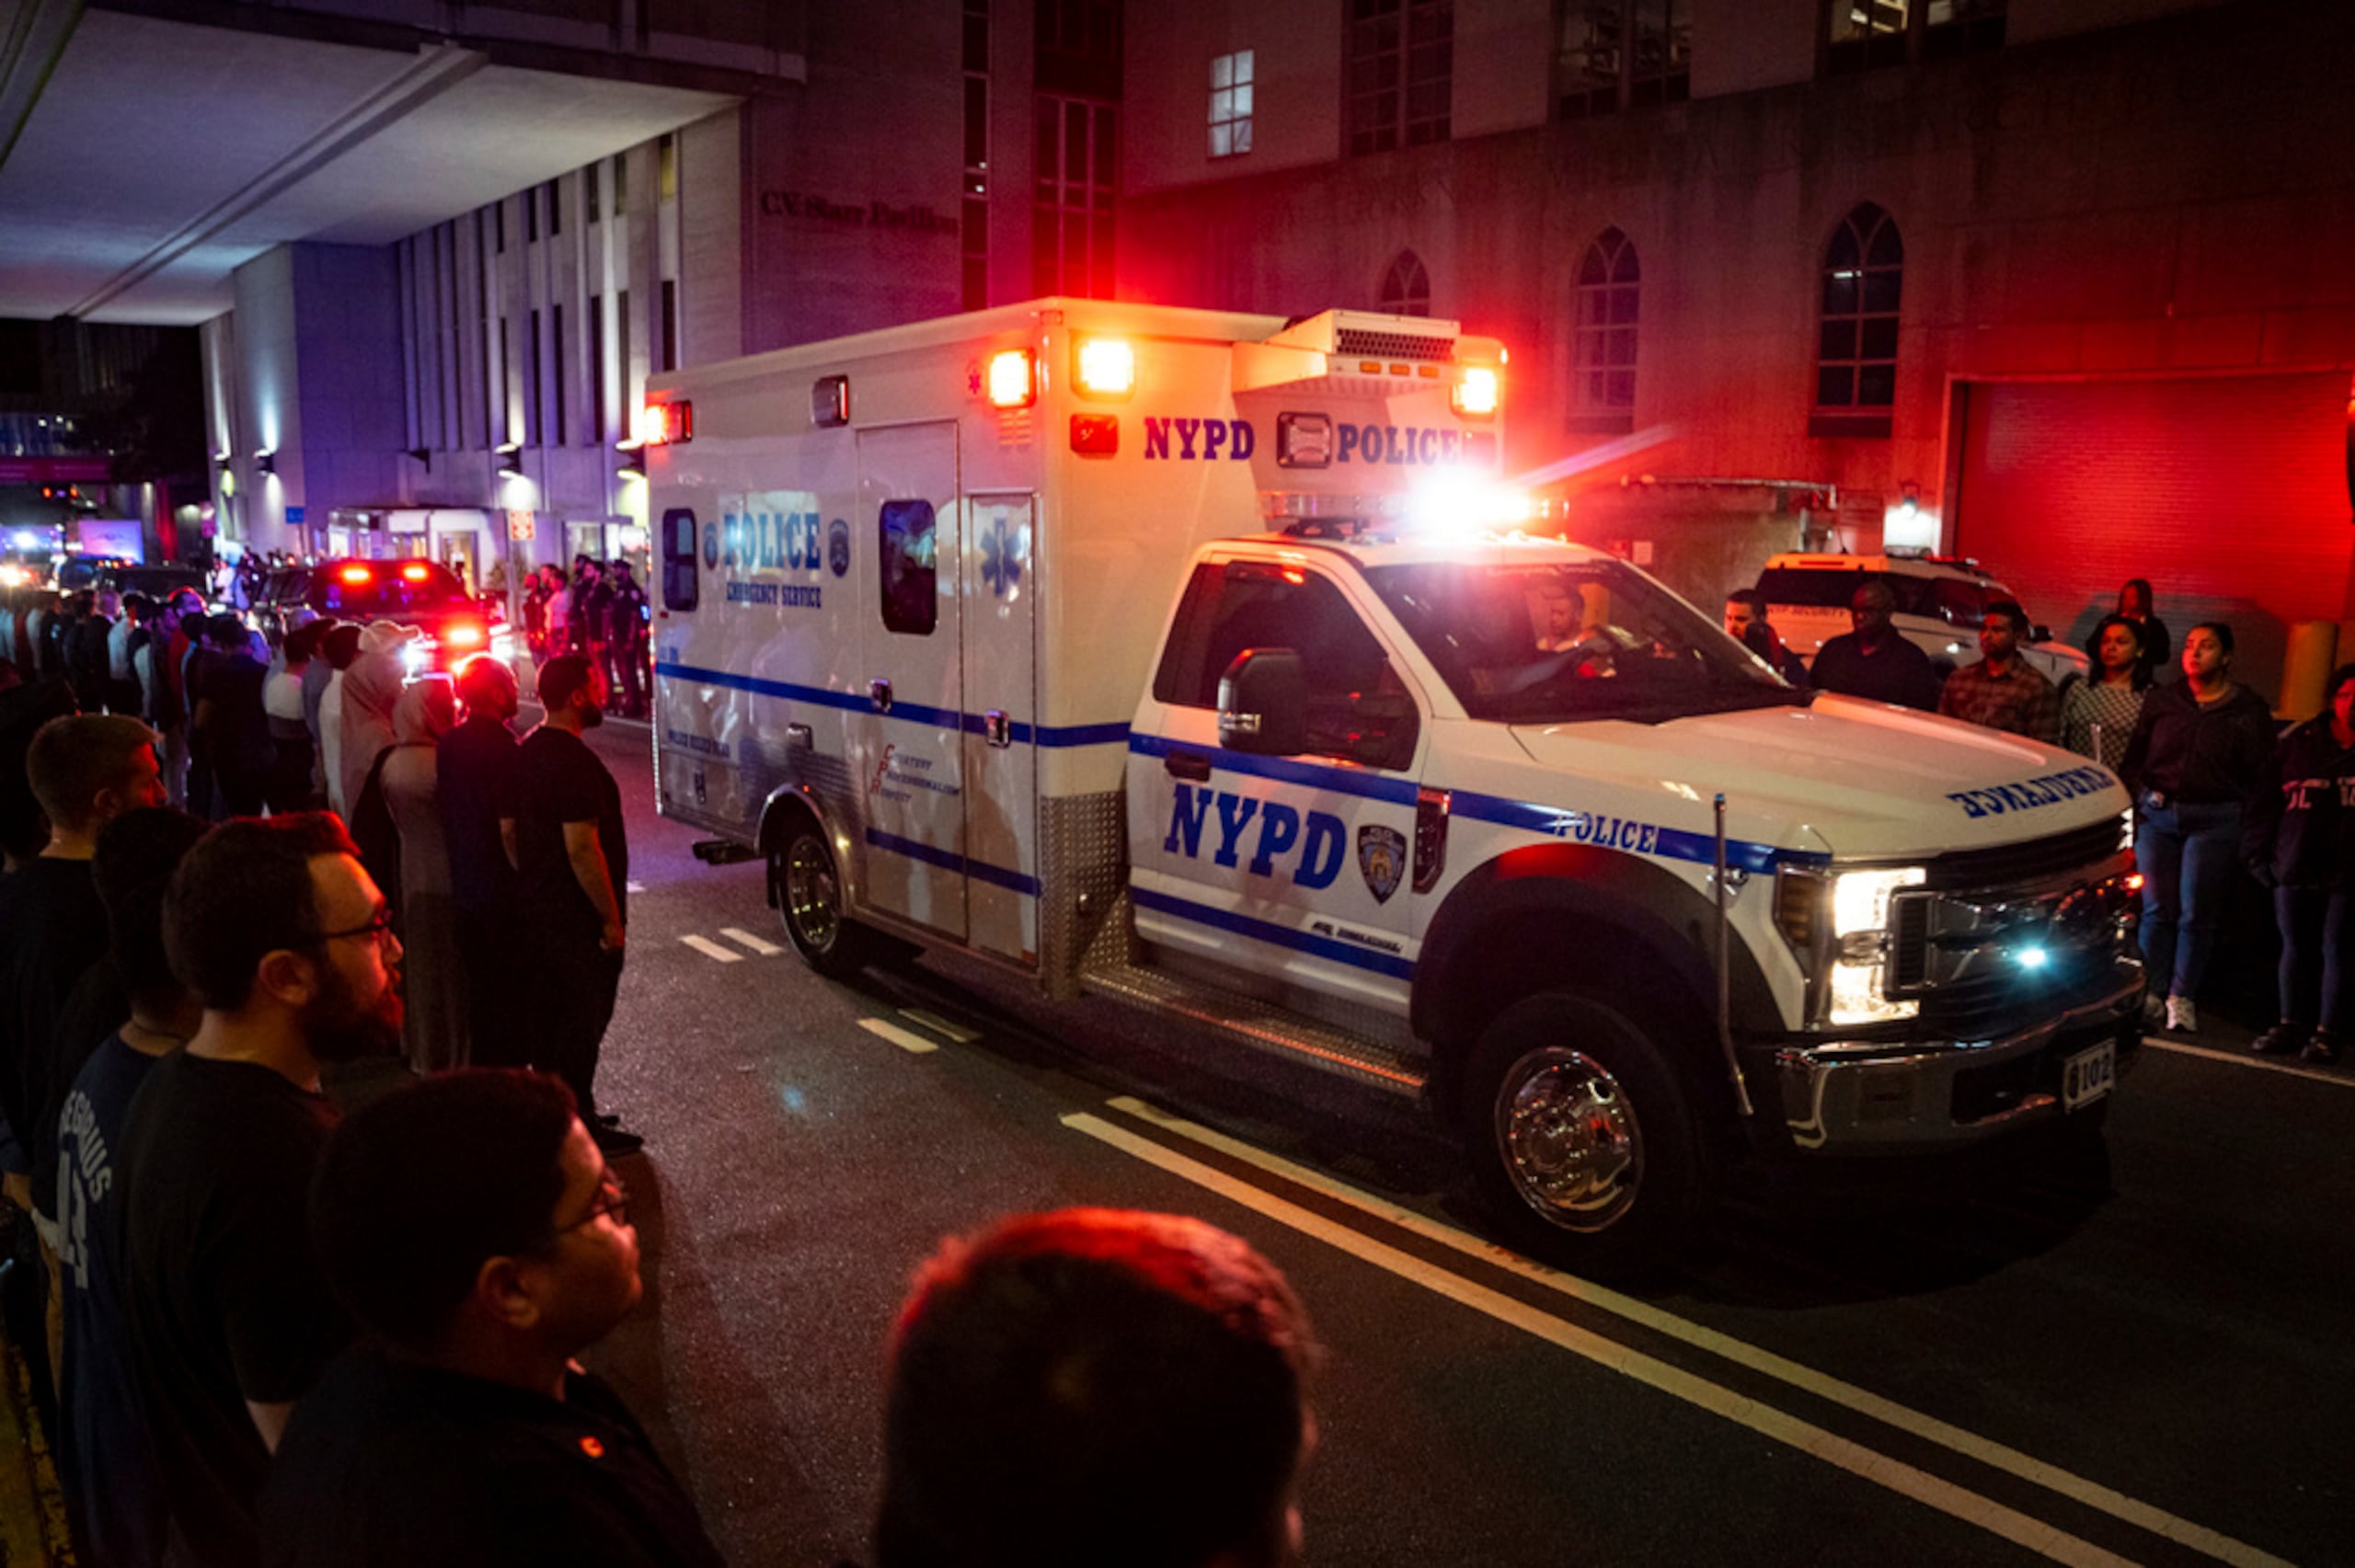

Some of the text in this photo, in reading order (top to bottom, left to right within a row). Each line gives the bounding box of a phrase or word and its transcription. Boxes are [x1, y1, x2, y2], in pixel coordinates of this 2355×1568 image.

[1144, 417, 1460, 465] NYPD POLICE
[724, 512, 821, 570] POLICE
[727, 581, 821, 610] EMERGENCY SERVICE
[1164, 783, 1347, 890] NYPD
[1557, 811, 1655, 854] POLICE
[2082, 1052, 2110, 1092] 102
